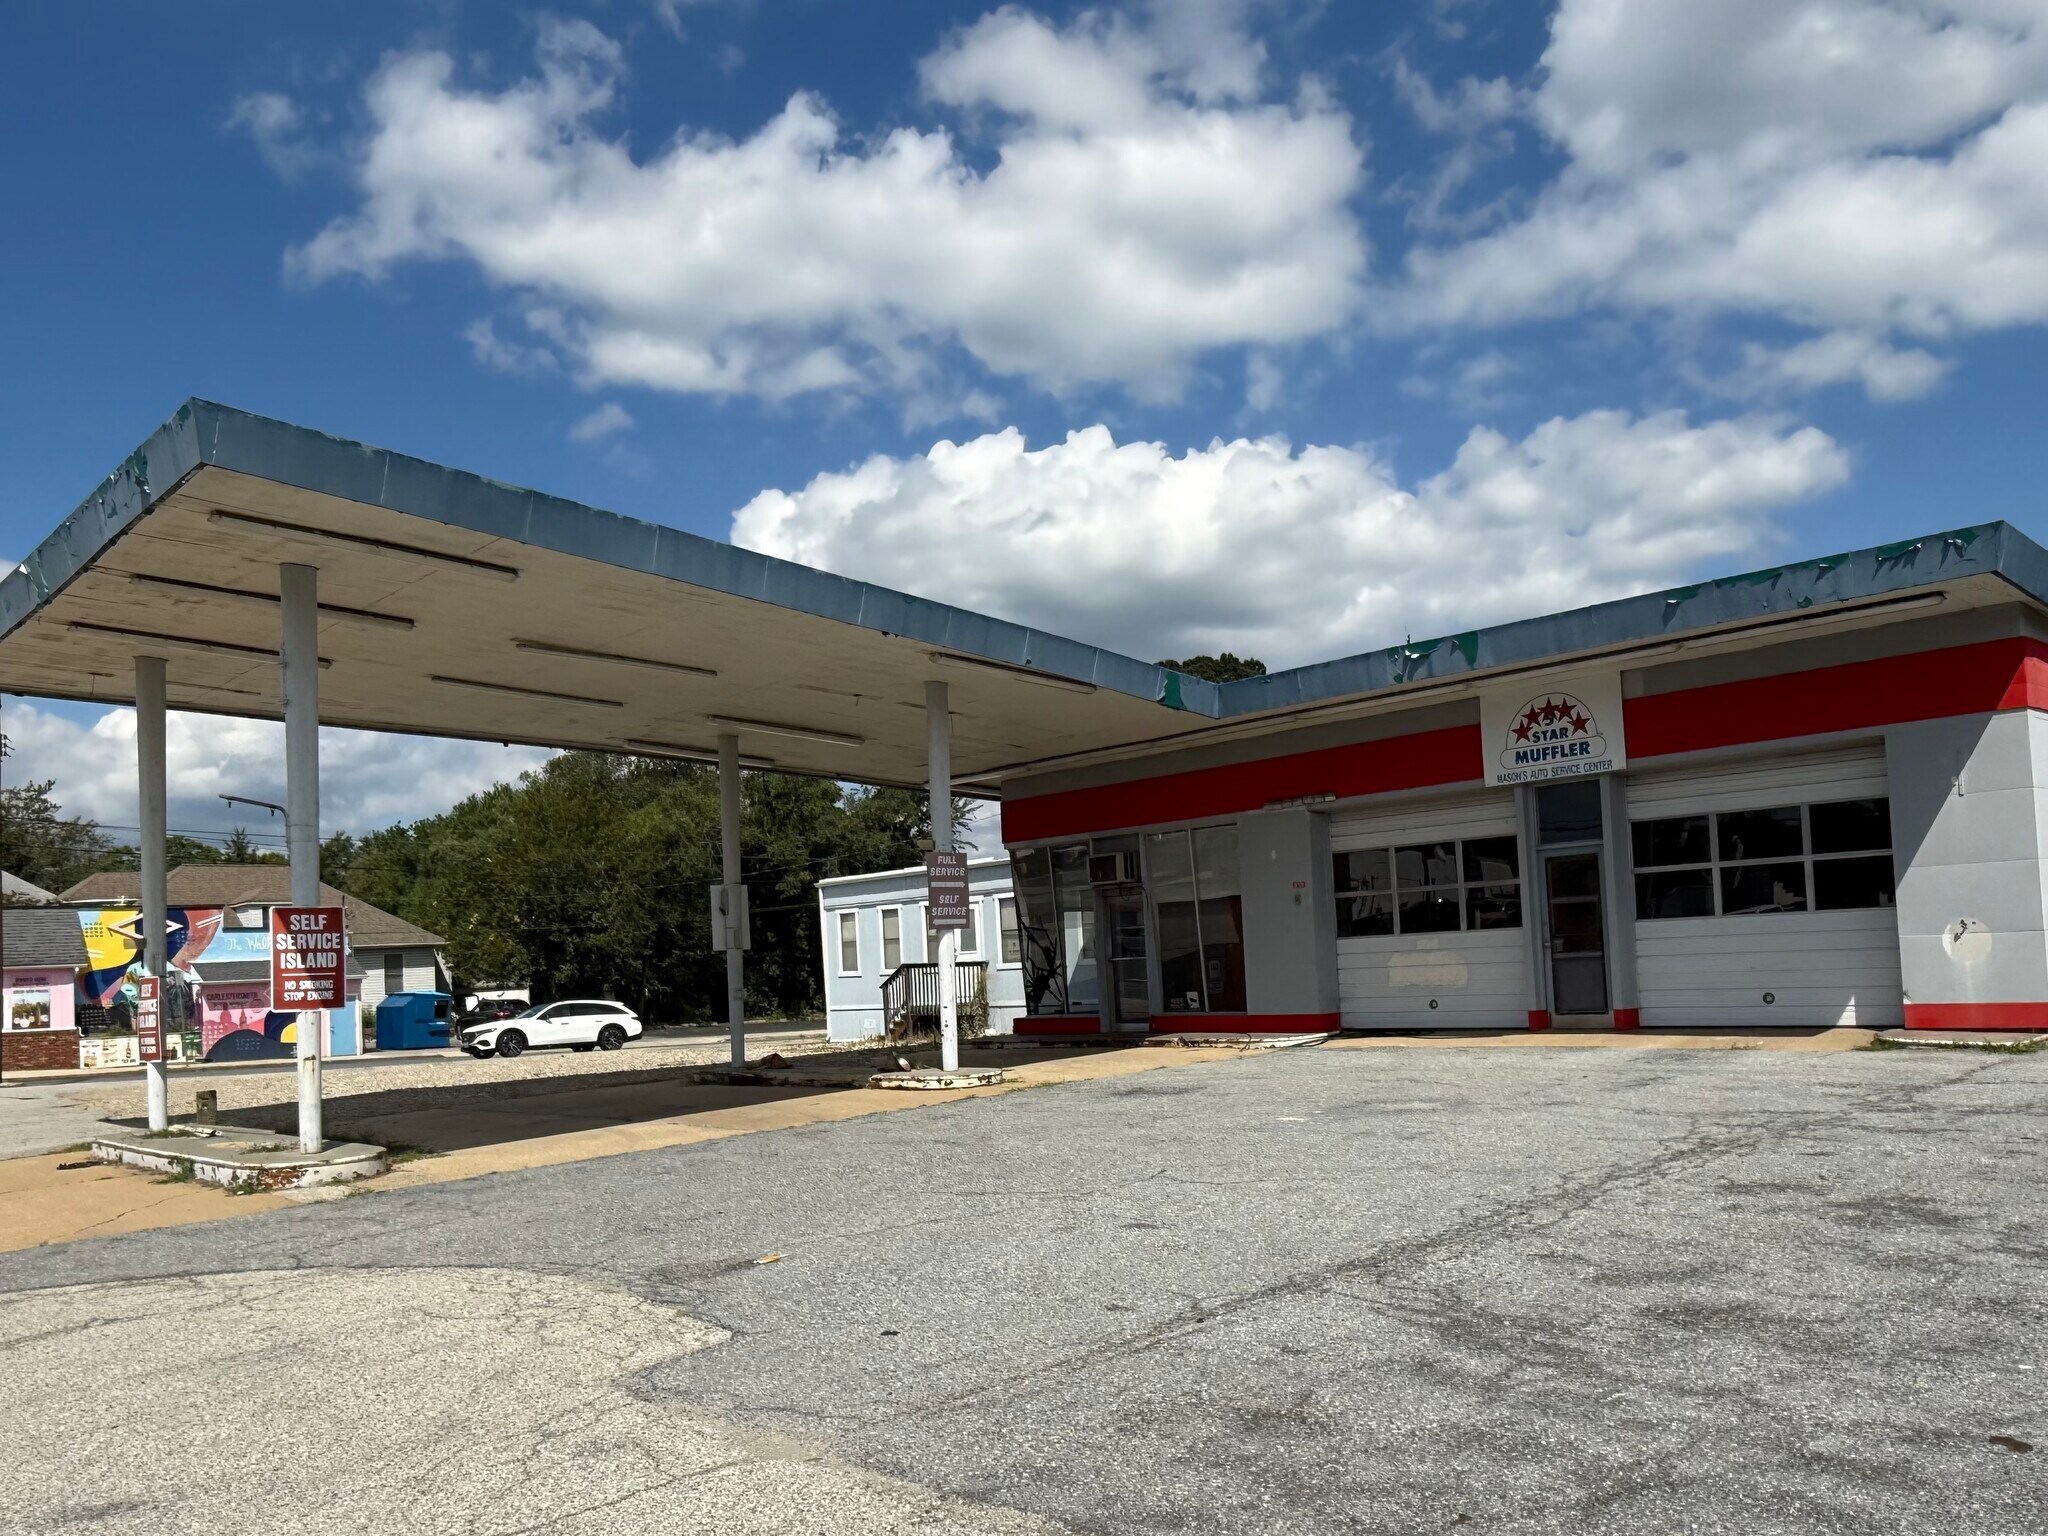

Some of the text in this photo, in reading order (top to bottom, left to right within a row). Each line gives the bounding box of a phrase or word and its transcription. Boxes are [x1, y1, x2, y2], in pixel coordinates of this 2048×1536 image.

[1532, 728, 1568, 742] STAR
[1516, 742, 1590, 763] MUFFLER
[1497, 761, 1612, 783] MASON'S AUTO SERVICE CENTER
[937, 856, 956, 864] FULL
[930, 867, 965, 876] SERVICE
[939, 895, 959, 904] SELF
[932, 907, 966, 915] SERVICE
[290, 915, 326, 930] SELF
[276, 932, 341, 950] SERVICE
[280, 952, 337, 969] ISLAND
[284, 980, 334, 990] NO SMOKING
[284, 990, 334, 1001] STOP ENGINE
